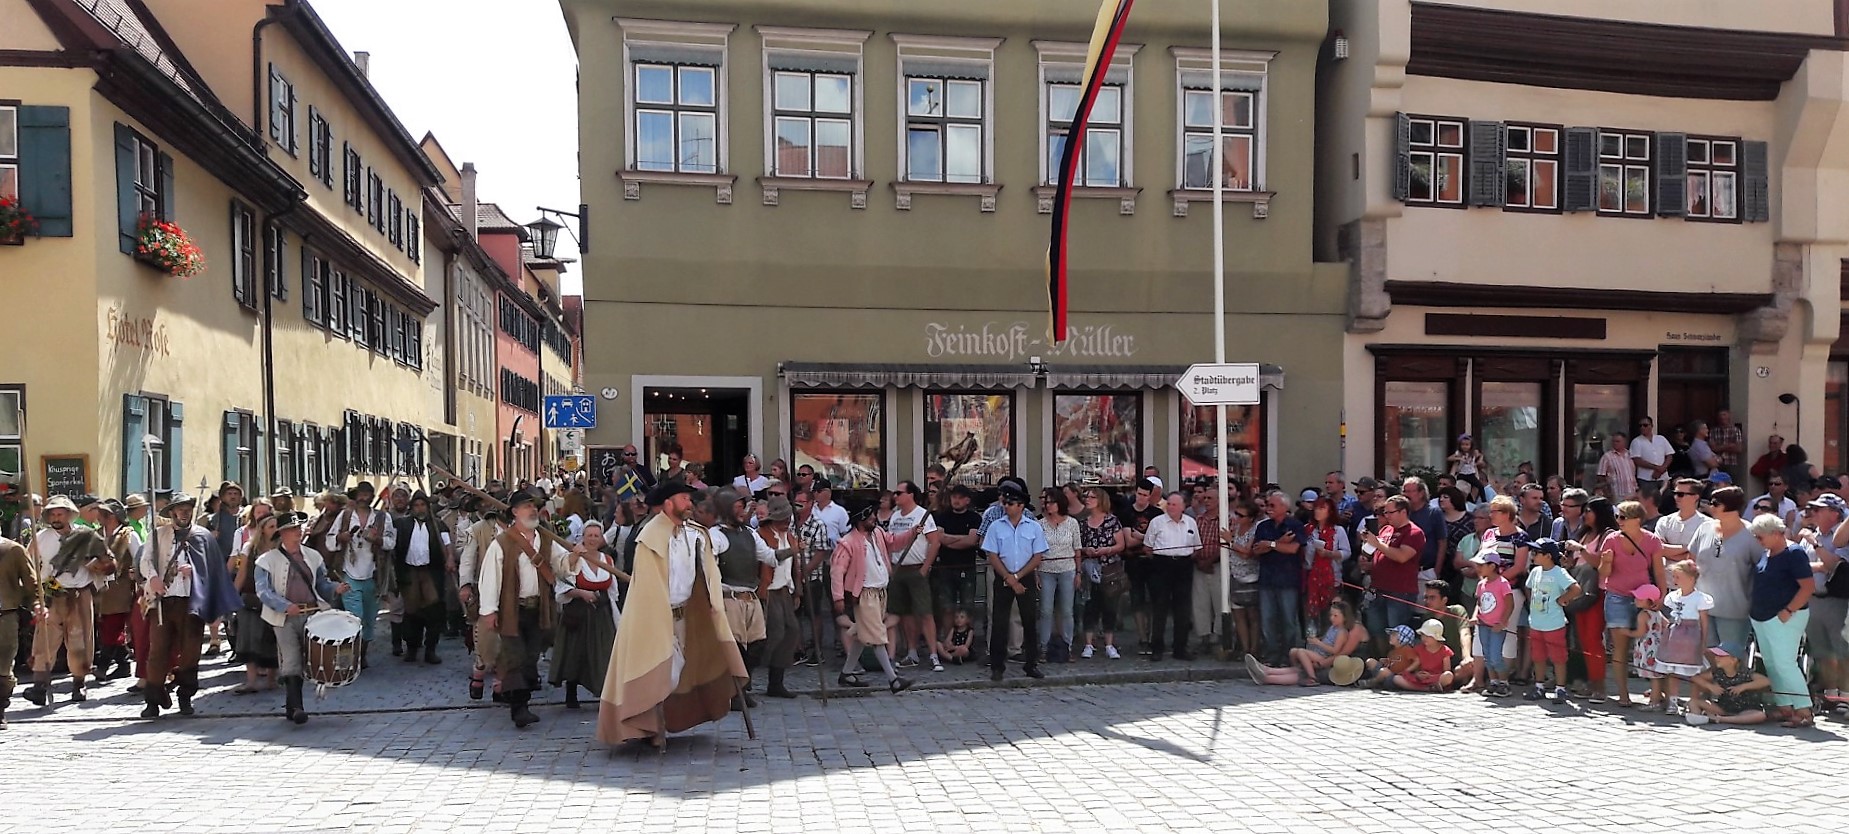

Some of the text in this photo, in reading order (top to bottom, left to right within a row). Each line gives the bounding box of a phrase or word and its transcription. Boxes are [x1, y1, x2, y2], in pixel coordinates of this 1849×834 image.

[1193, 374, 1256, 386] Stadtübergabe
[1201, 386, 1219, 396] Platz
[47, 476, 84, 489] Spanferkel
